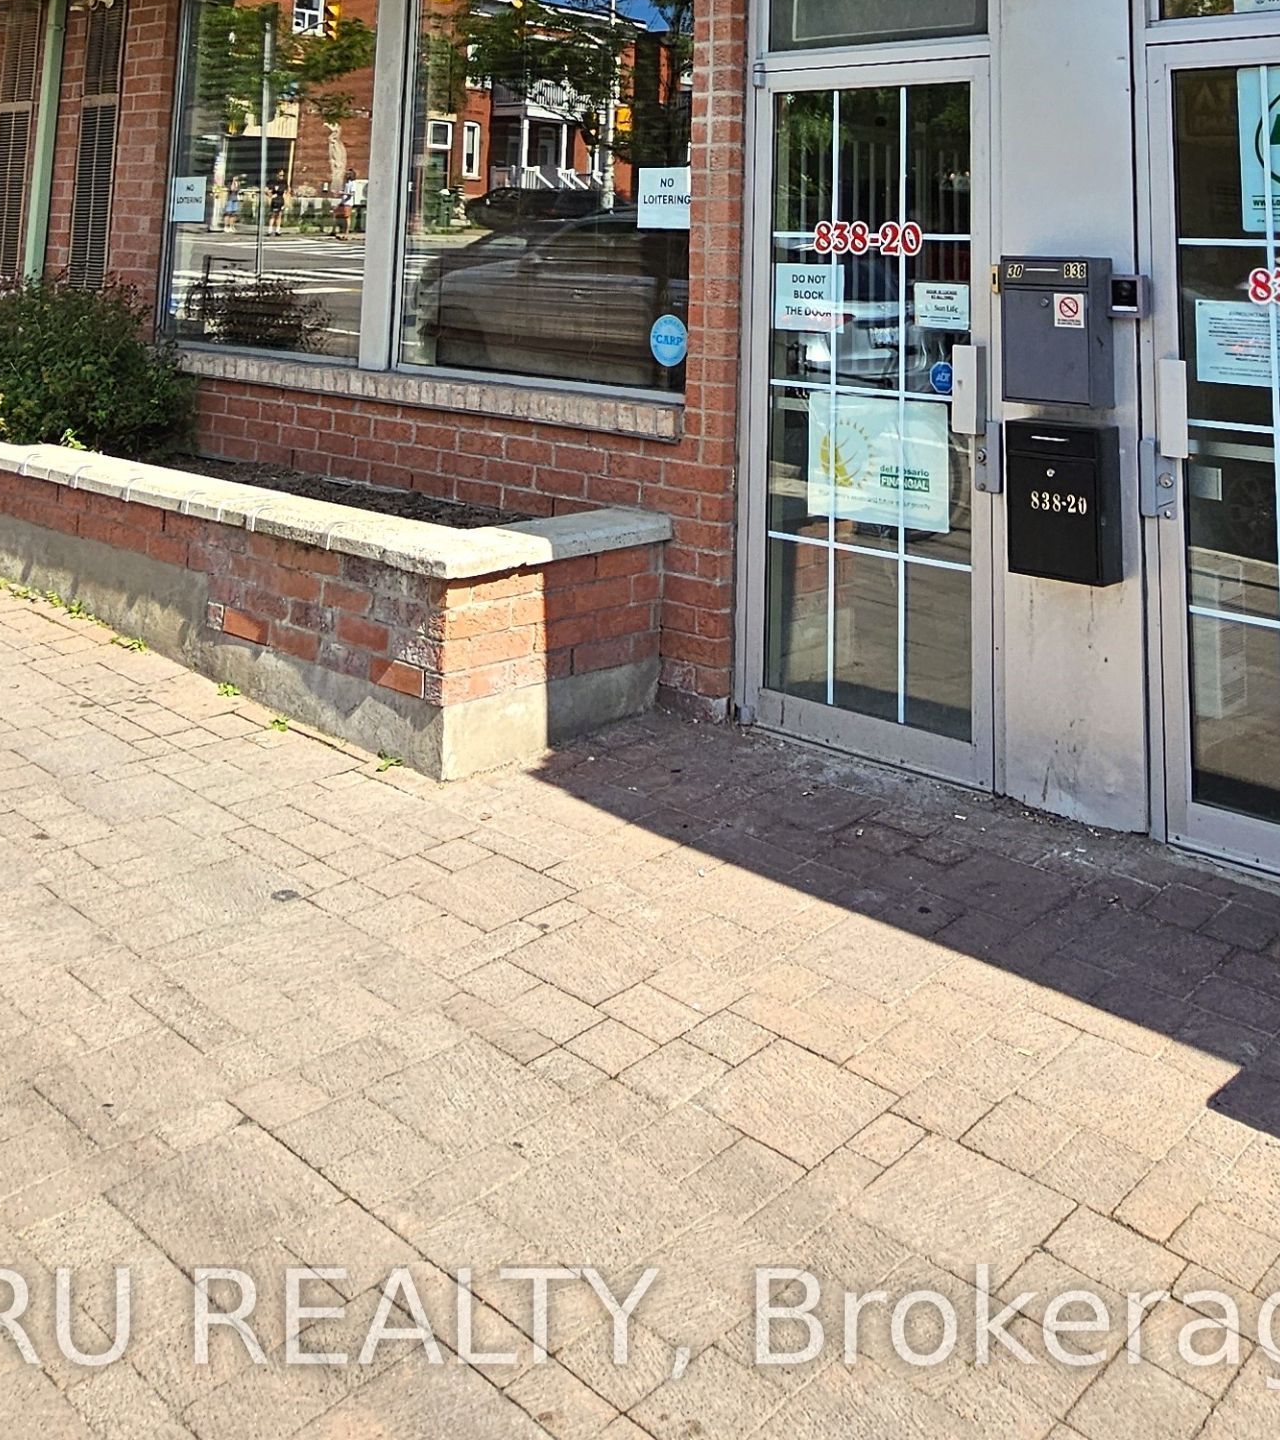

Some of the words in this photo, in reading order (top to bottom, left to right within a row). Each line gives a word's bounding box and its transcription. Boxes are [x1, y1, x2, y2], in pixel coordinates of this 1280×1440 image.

[660, 178, 674, 187] NO
[643, 195, 691, 205] LOITERING
[814, 221, 922, 256] 838-20
[1008, 265, 1022, 277] 30
[1064, 264, 1085, 277] 838
[792, 274, 805, 283] DO
[808, 275, 826, 284] NOT
[793, 290, 824, 300] BLOCK
[785, 306, 802, 315] THE
[947, 305, 959, 313] Life
[656, 334, 683, 345] CARP
[936, 373, 950, 382] ADT
[1031, 490, 1087, 515] 838-20
